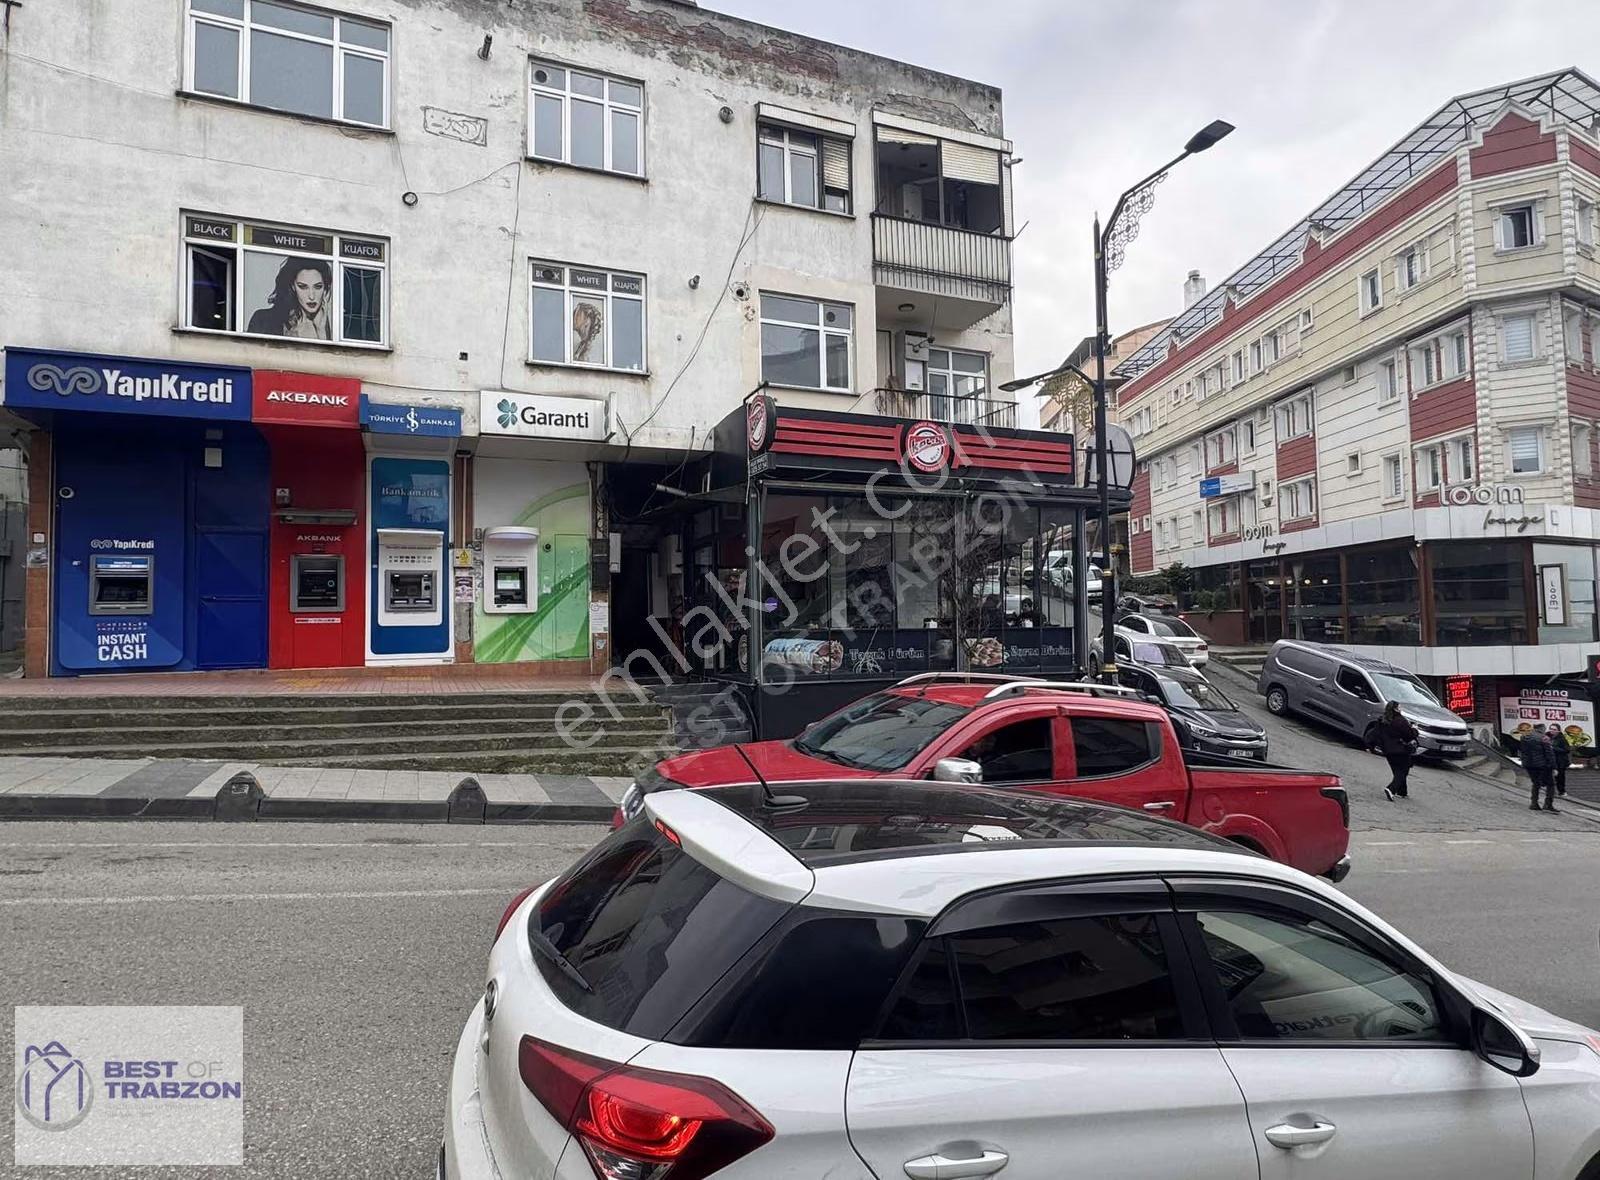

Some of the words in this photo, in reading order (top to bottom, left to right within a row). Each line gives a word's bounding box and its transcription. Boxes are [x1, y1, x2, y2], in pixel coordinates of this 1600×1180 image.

[193, 223, 229, 237] BLACK
[273, 234, 307, 248] WHITE
[576, 275, 600, 286] WHITE
[102, 368, 233, 403] YapıKredi
[266, 390, 348, 406] AKBANK
[369, 414, 405, 424] TÜRKİYE
[420, 418, 456, 427] BANKASI
[520, 406, 589, 429] Garanti
[1439, 482, 1525, 506] loom
[97, 633, 146, 646] INSTANT
[98, 644, 148, 661] CASH
[1521, 688, 1569, 698] nirvana
